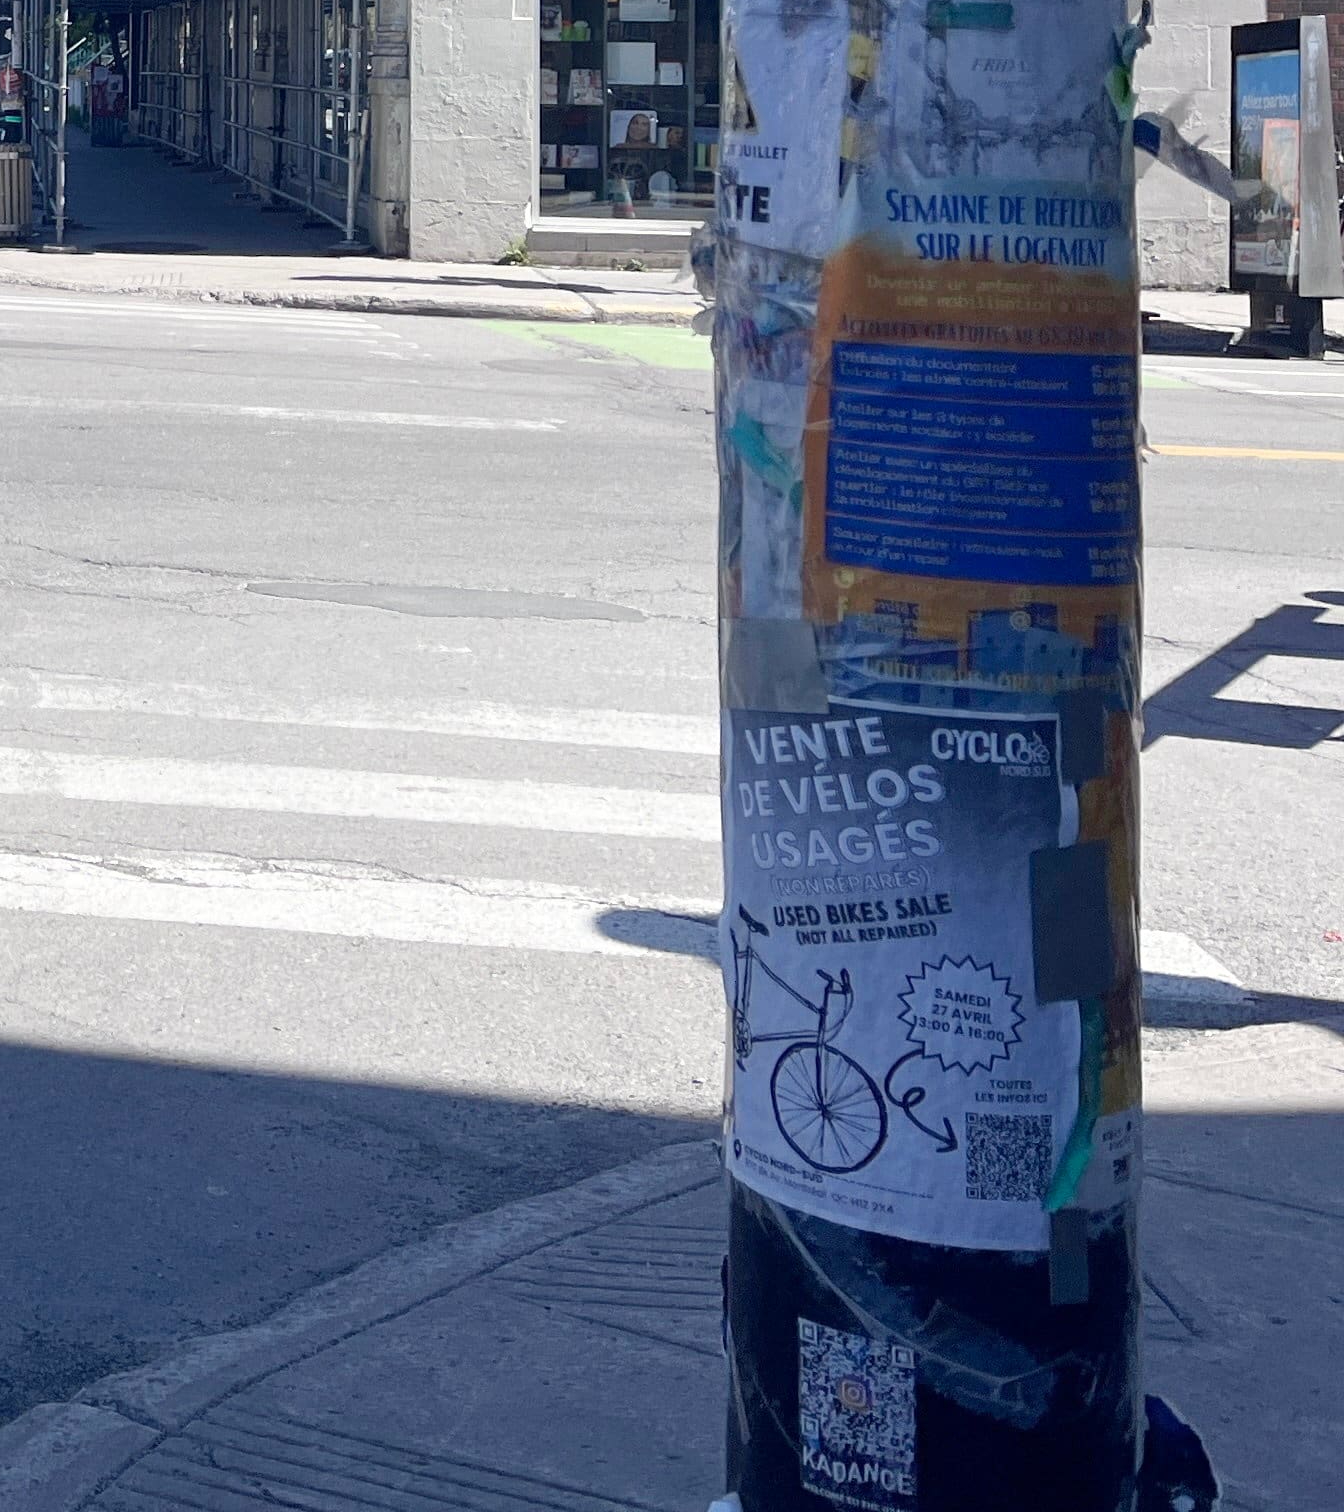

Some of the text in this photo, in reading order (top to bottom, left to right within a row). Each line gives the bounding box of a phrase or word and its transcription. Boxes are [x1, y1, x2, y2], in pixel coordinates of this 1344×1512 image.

[886, 189, 991, 225] SEMAINE
[998, 195, 1026, 226] DE
[916, 233, 1108, 268] SUR LE LOGEMENT
[745, 717, 1030, 764] VENTE CYCLO
[739, 762, 946, 817] DE VÉLOS
[751, 808, 940, 869] USAGÉS
[773, 893, 952, 928] USED BIKES SALE
[796, 920, 937, 946] (NOT ALL REPAIRED)
[932, 1004, 992, 1025] 27 AVRIL
[934, 988, 991, 1008] SAMEDI
[968, 1026, 1005, 1042] 16:00
[975, 1092, 994, 1103] LES
[990, 1080, 1032, 1090] TOUTES
[803, 1445, 915, 1496] KADANCE
